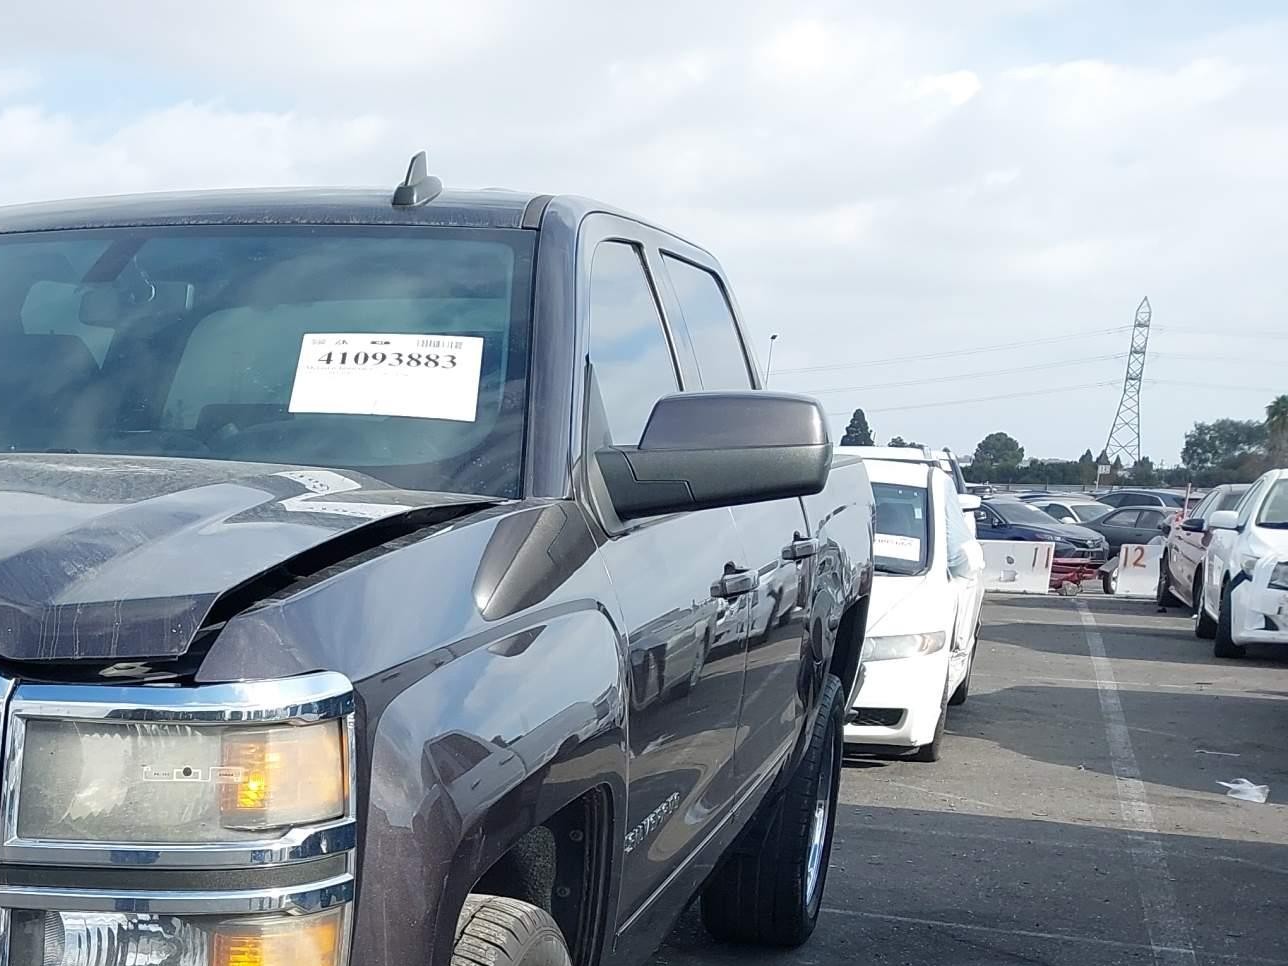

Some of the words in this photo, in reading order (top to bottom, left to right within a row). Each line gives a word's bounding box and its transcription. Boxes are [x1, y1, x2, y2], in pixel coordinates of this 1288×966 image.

[317, 351, 458, 369] 41093883
[1031, 546, 1052, 569] 11
[1122, 545, 1147, 568] 12
